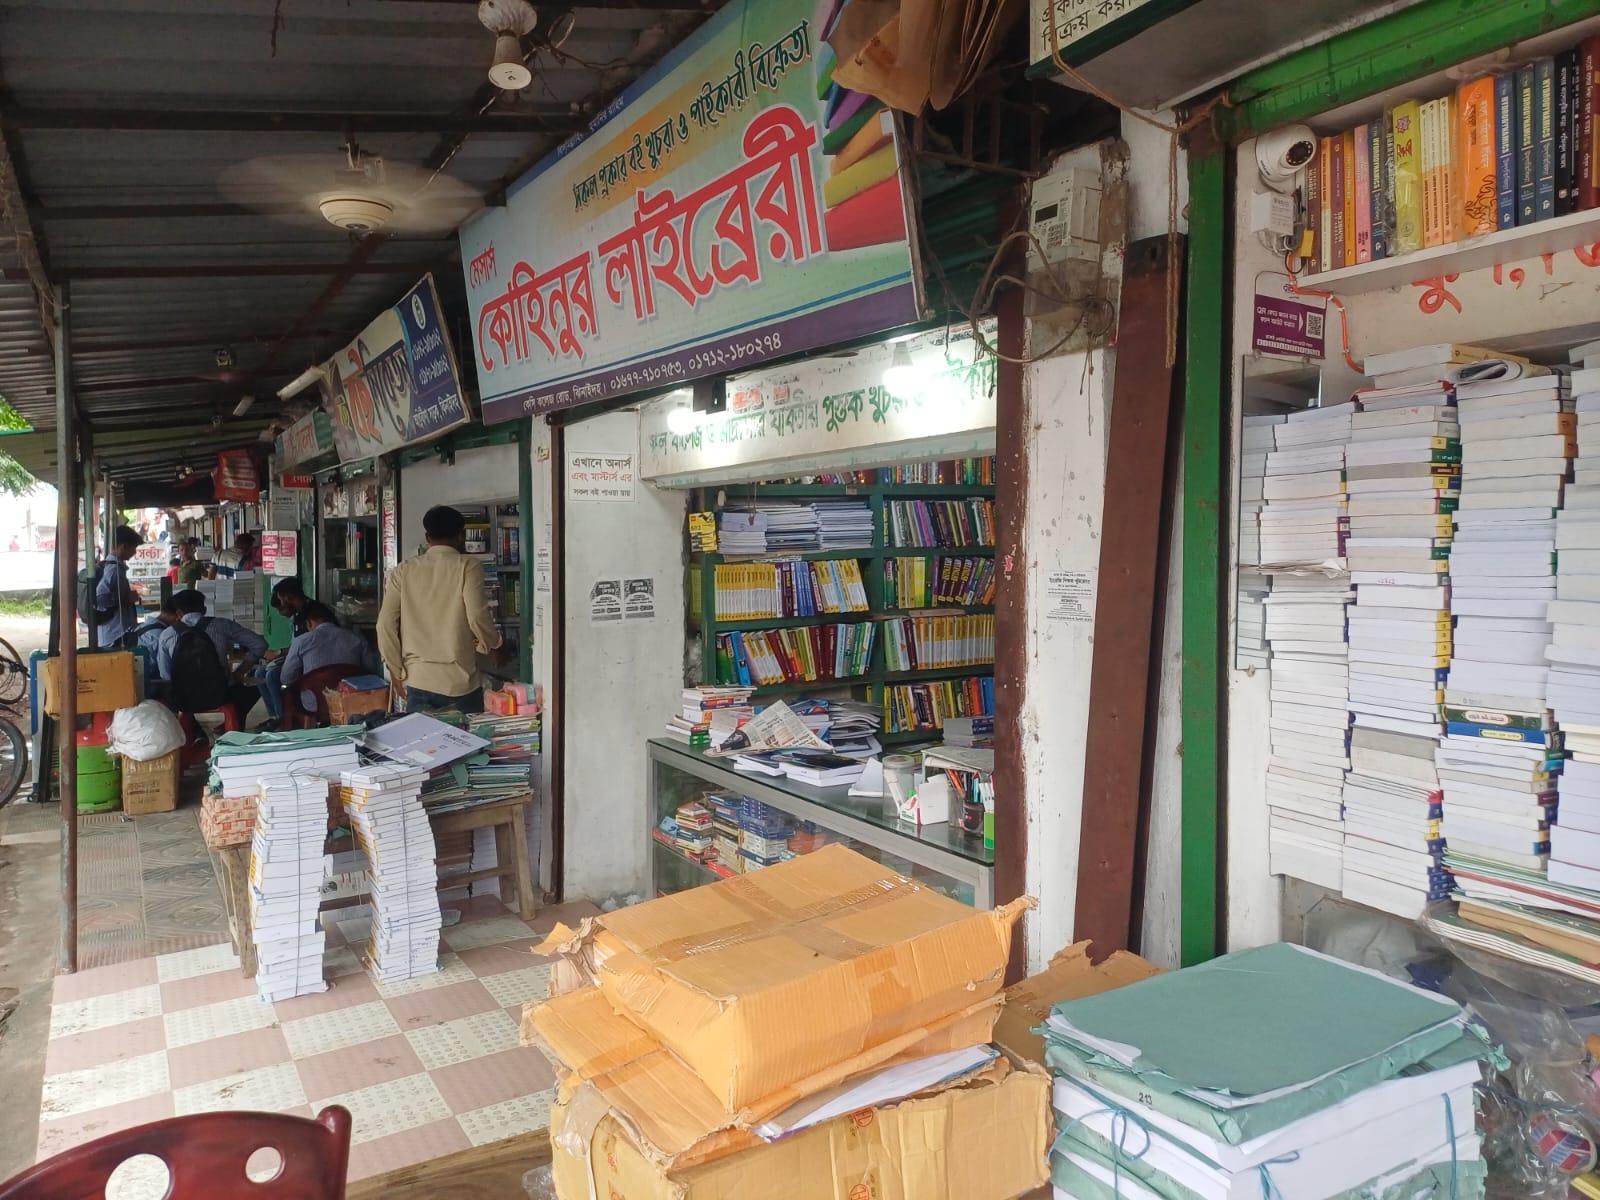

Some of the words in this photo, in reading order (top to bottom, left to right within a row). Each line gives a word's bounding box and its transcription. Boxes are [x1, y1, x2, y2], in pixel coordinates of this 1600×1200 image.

[573, 173, 600, 208] সকল
[599, 152, 628, 196] প্রকার
[628, 132, 646, 170] বই
[645, 118, 676, 170] খুচরা
[677, 113, 689, 141] ও
[690, 50, 747, 128] পাইকারী
[748, 19, 812, 92] বিক্রেতা
[598, 105, 825, 319] লাইব্রেরী
[571, 472, 589, 482] এবং
[590, 470, 618, 482] মাস্টার্স
[572, 457, 602, 469] এখানে
[605, 456, 632, 470] অনার্স
